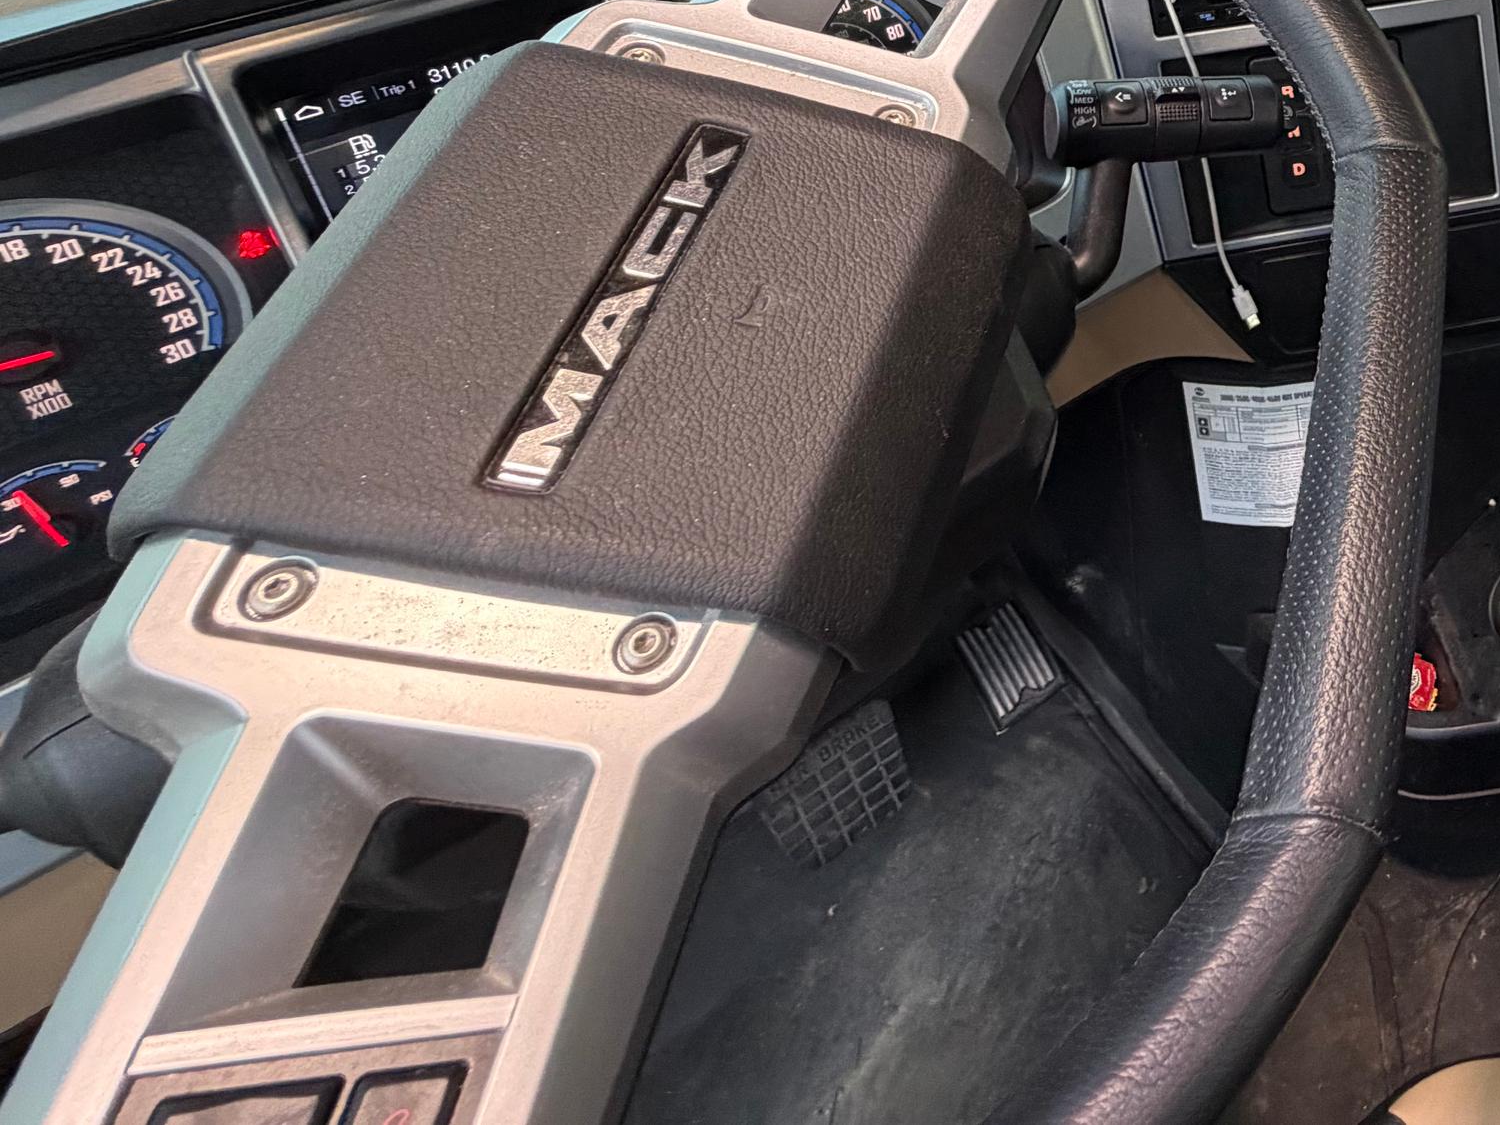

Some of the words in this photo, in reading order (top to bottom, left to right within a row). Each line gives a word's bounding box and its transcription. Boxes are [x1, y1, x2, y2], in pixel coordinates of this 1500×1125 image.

[863, 5, 882, 23] 70
[886, 23, 906, 42] 80
[338, 90, 367, 108] SE
[379, 84, 406, 98] Trip
[1074, 96, 1094, 104] MED
[1073, 106, 1096, 115] HIGH
[1292, 162, 1306, 176] D
[0, 238, 31, 263] 18
[46, 238, 84, 264] 20
[91, 247, 129, 273] 22
[126, 261, 163, 287] 24
[150, 282, 186, 307] 26
[498, 136, 741, 477] MACK
[162, 308, 199, 334] 28
[160, 338, 197, 364] 30
[19, 379, 63, 404] RPM
[26, 392, 73, 420] X100
